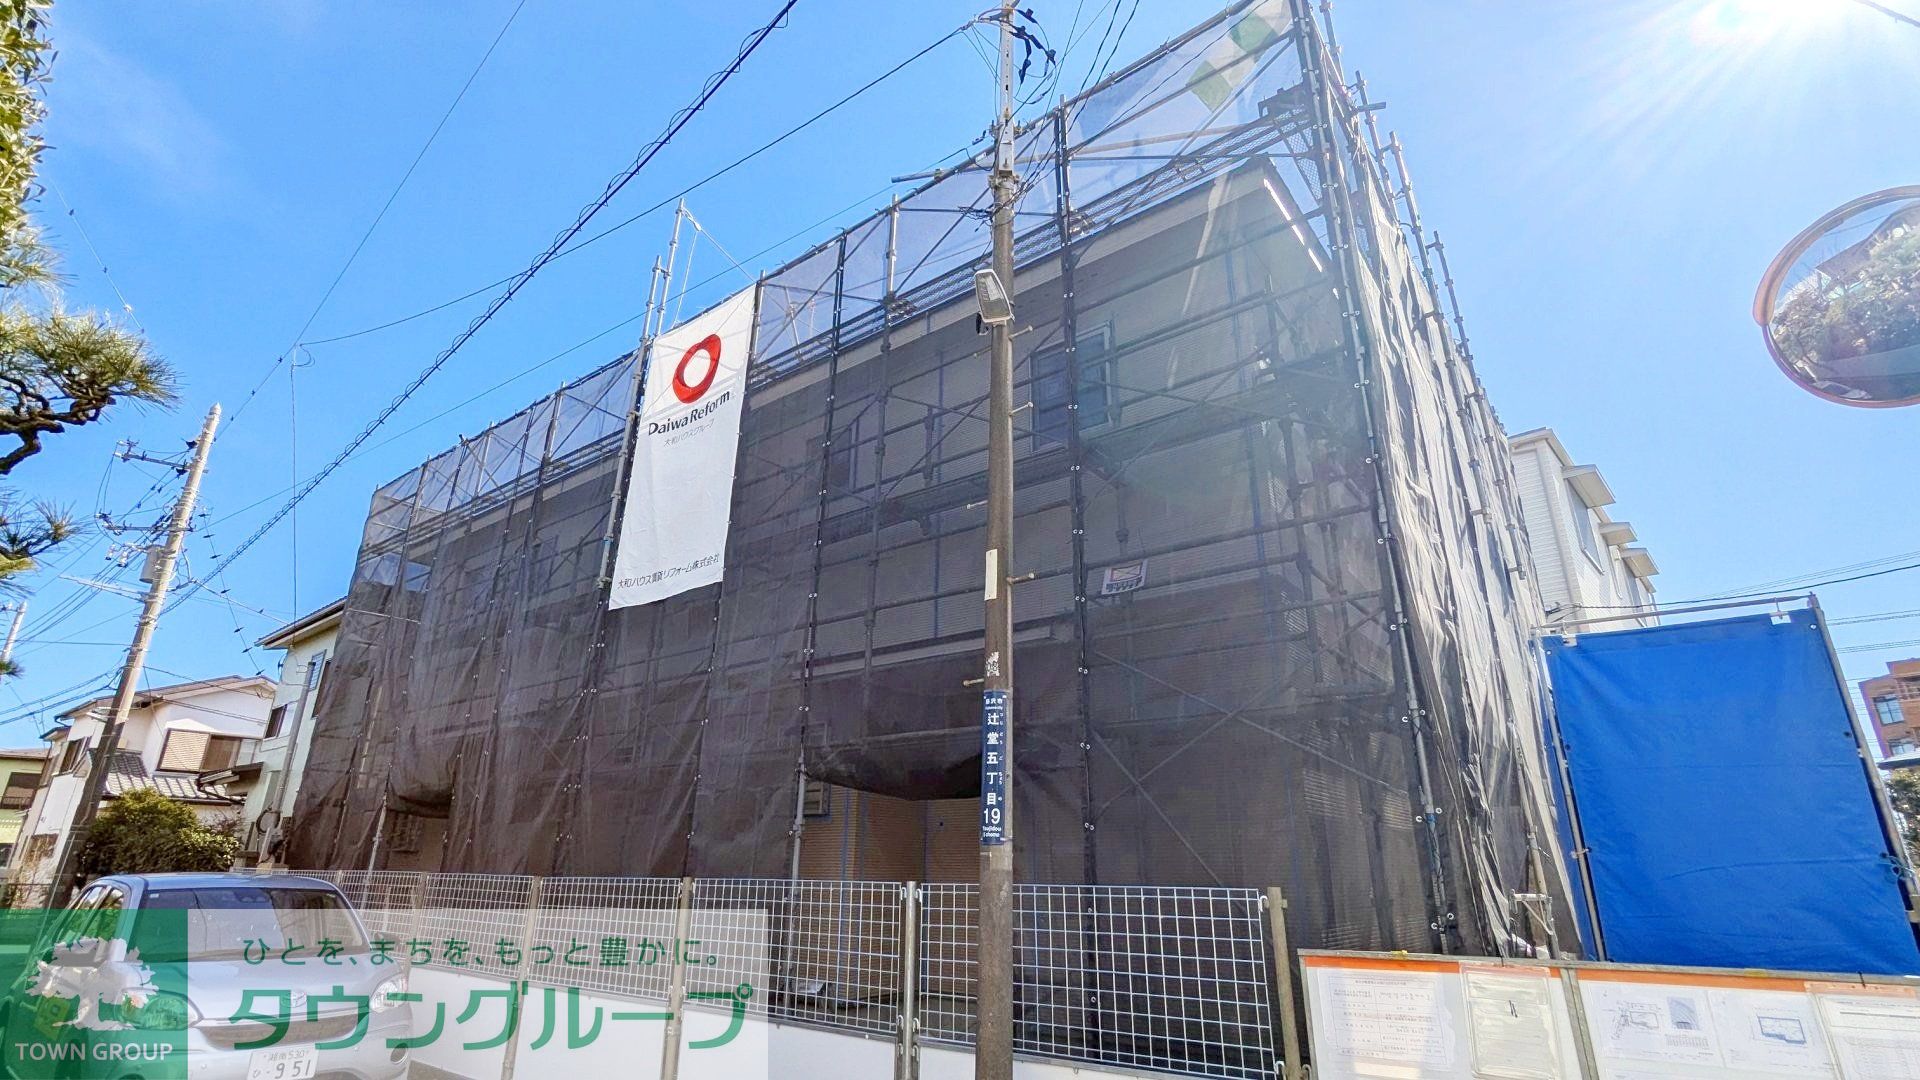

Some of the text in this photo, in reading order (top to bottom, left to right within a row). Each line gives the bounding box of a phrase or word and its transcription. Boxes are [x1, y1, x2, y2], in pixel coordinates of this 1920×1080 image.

[648, 391, 730, 435] Daiwa Reform
[987, 712, 1000, 805] 辻堂五丁目
[983, 808, 1001, 824] 19
